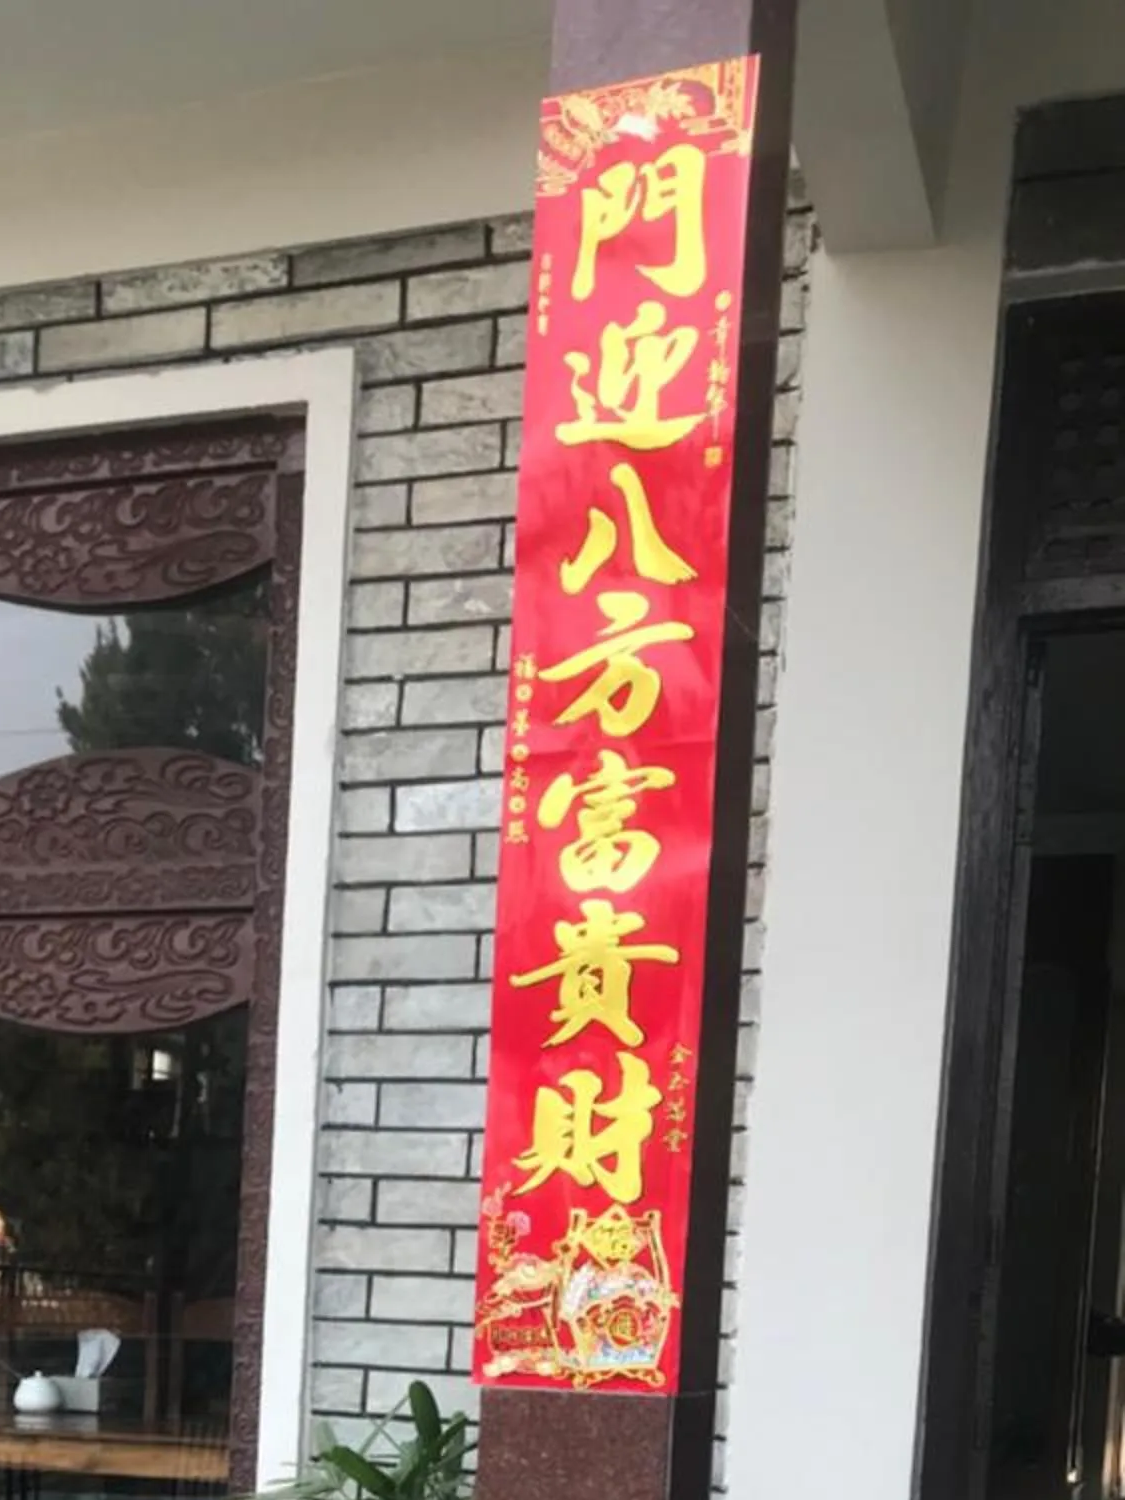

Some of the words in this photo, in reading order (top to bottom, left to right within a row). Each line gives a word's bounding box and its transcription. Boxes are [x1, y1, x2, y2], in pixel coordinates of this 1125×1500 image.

[509, 144, 707, 1204] 門迎八方富貴財
